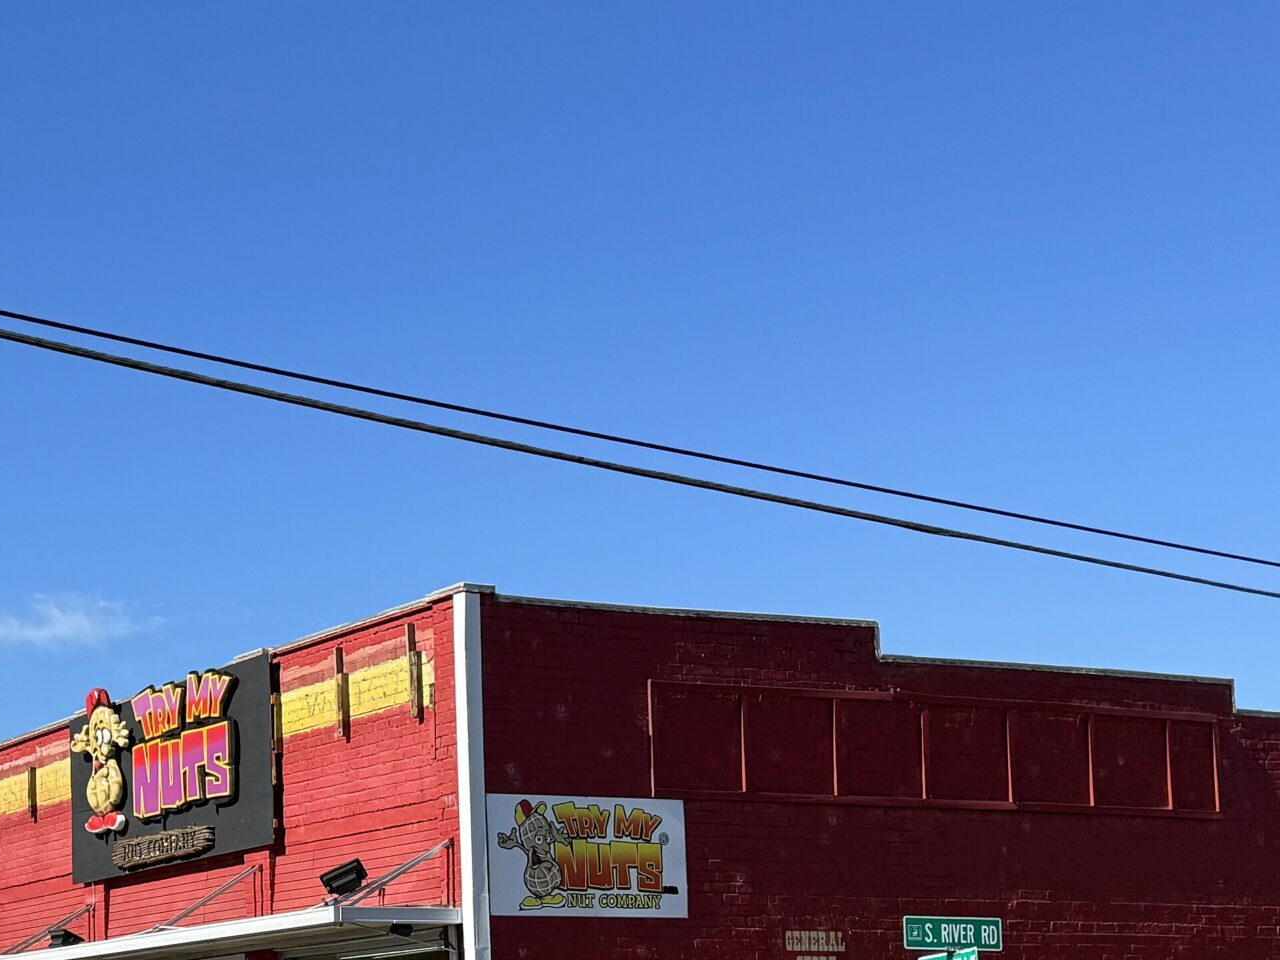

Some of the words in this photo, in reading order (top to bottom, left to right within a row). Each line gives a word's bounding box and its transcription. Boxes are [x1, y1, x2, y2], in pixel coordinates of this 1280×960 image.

[131, 683, 184, 739] TRY
[186, 671, 233, 723] MY
[132, 720, 231, 820] NUTS
[552, 800, 610, 838] TRY
[614, 803, 661, 840] MY
[554, 838, 663, 892] NUTS
[568, 893, 595, 908] NUT
[599, 893, 662, 909] COMPANY
[785, 930, 846, 951] GENERAL
[924, 923, 938, 943] S.
[941, 923, 975, 944] RIVER
[981, 925, 998, 945] RD
